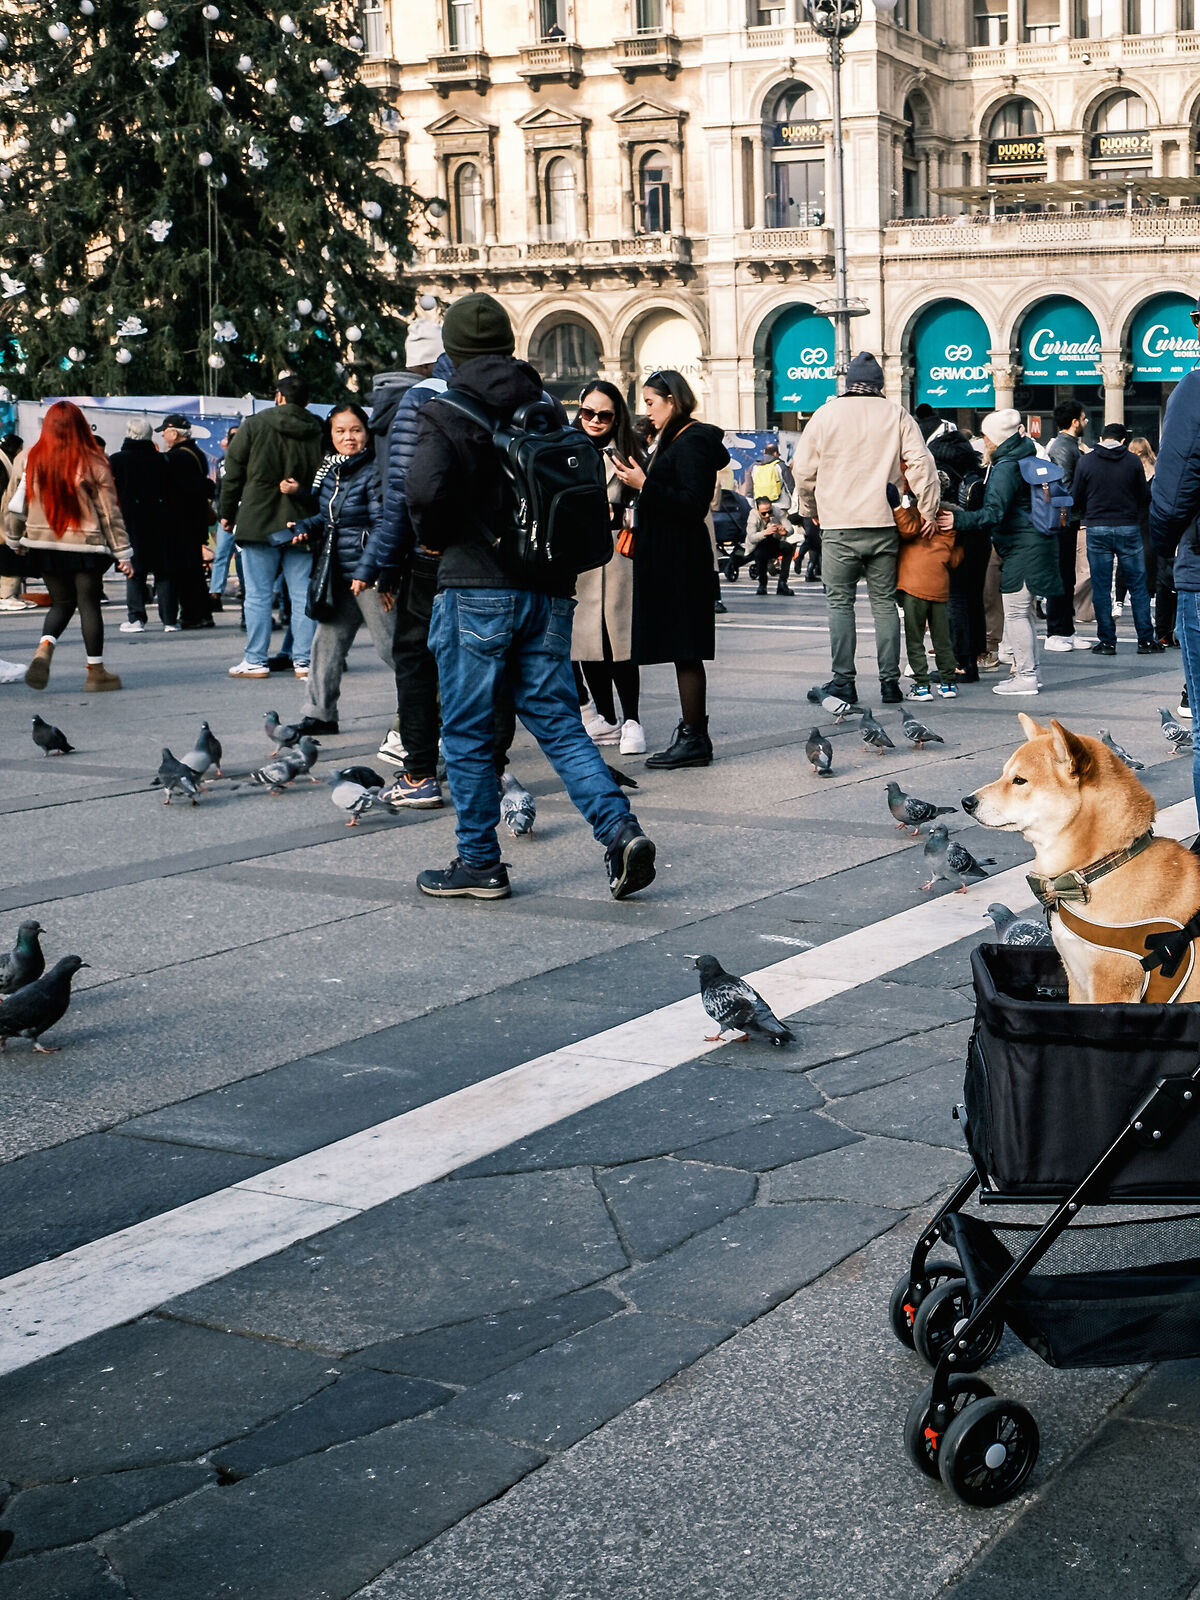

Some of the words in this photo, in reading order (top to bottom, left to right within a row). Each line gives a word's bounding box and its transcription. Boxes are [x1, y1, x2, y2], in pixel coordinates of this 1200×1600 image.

[782, 125, 818, 138] DUOMO
[998, 143, 1036, 156] DUOMO
[1100, 137, 1139, 149] DUOMO
[1029, 328, 1101, 361] Currado
